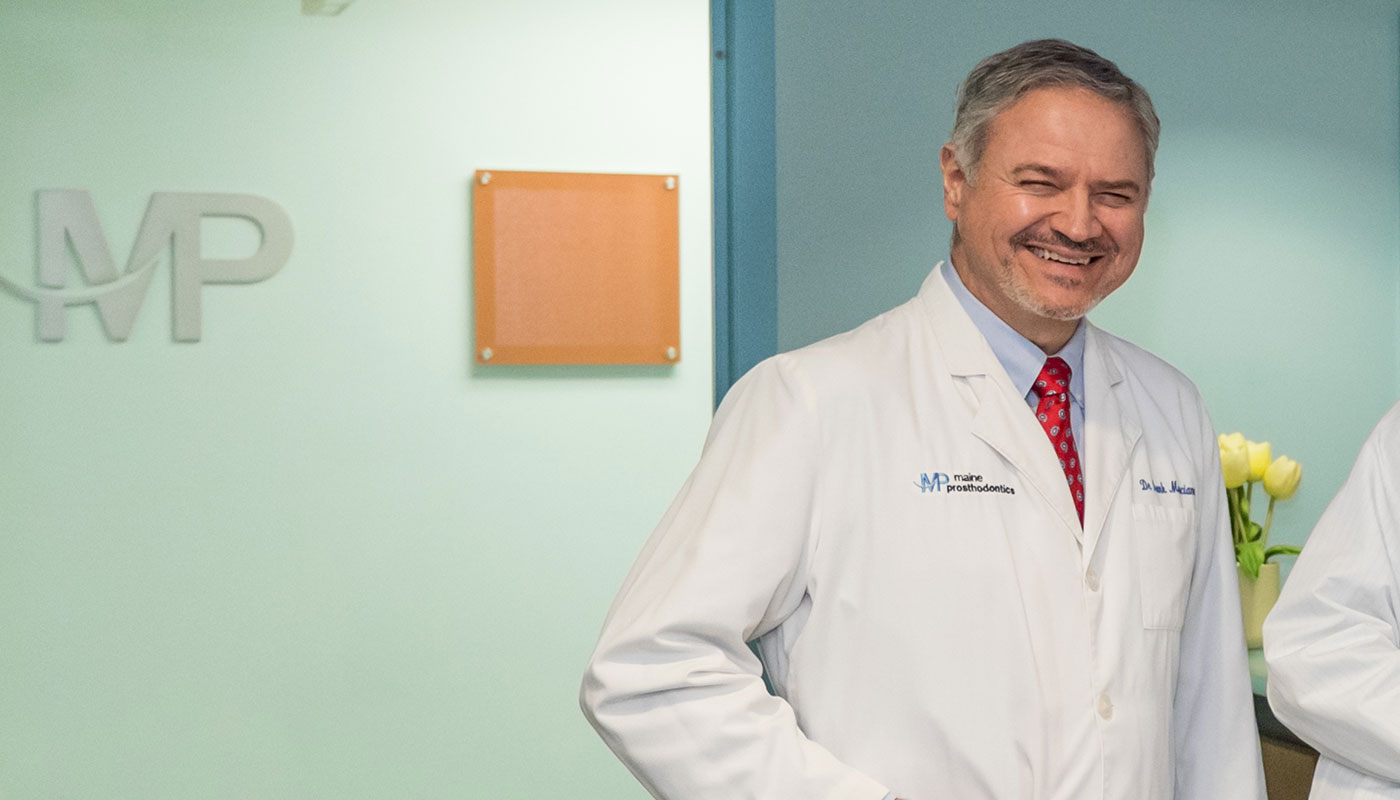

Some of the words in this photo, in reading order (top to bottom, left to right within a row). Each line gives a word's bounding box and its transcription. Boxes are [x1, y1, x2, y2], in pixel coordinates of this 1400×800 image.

[34, 187, 295, 344] MP
[918, 472, 950, 493] MP
[953, 473, 983, 482] maine
[946, 483, 1015, 494] prosthodontics
